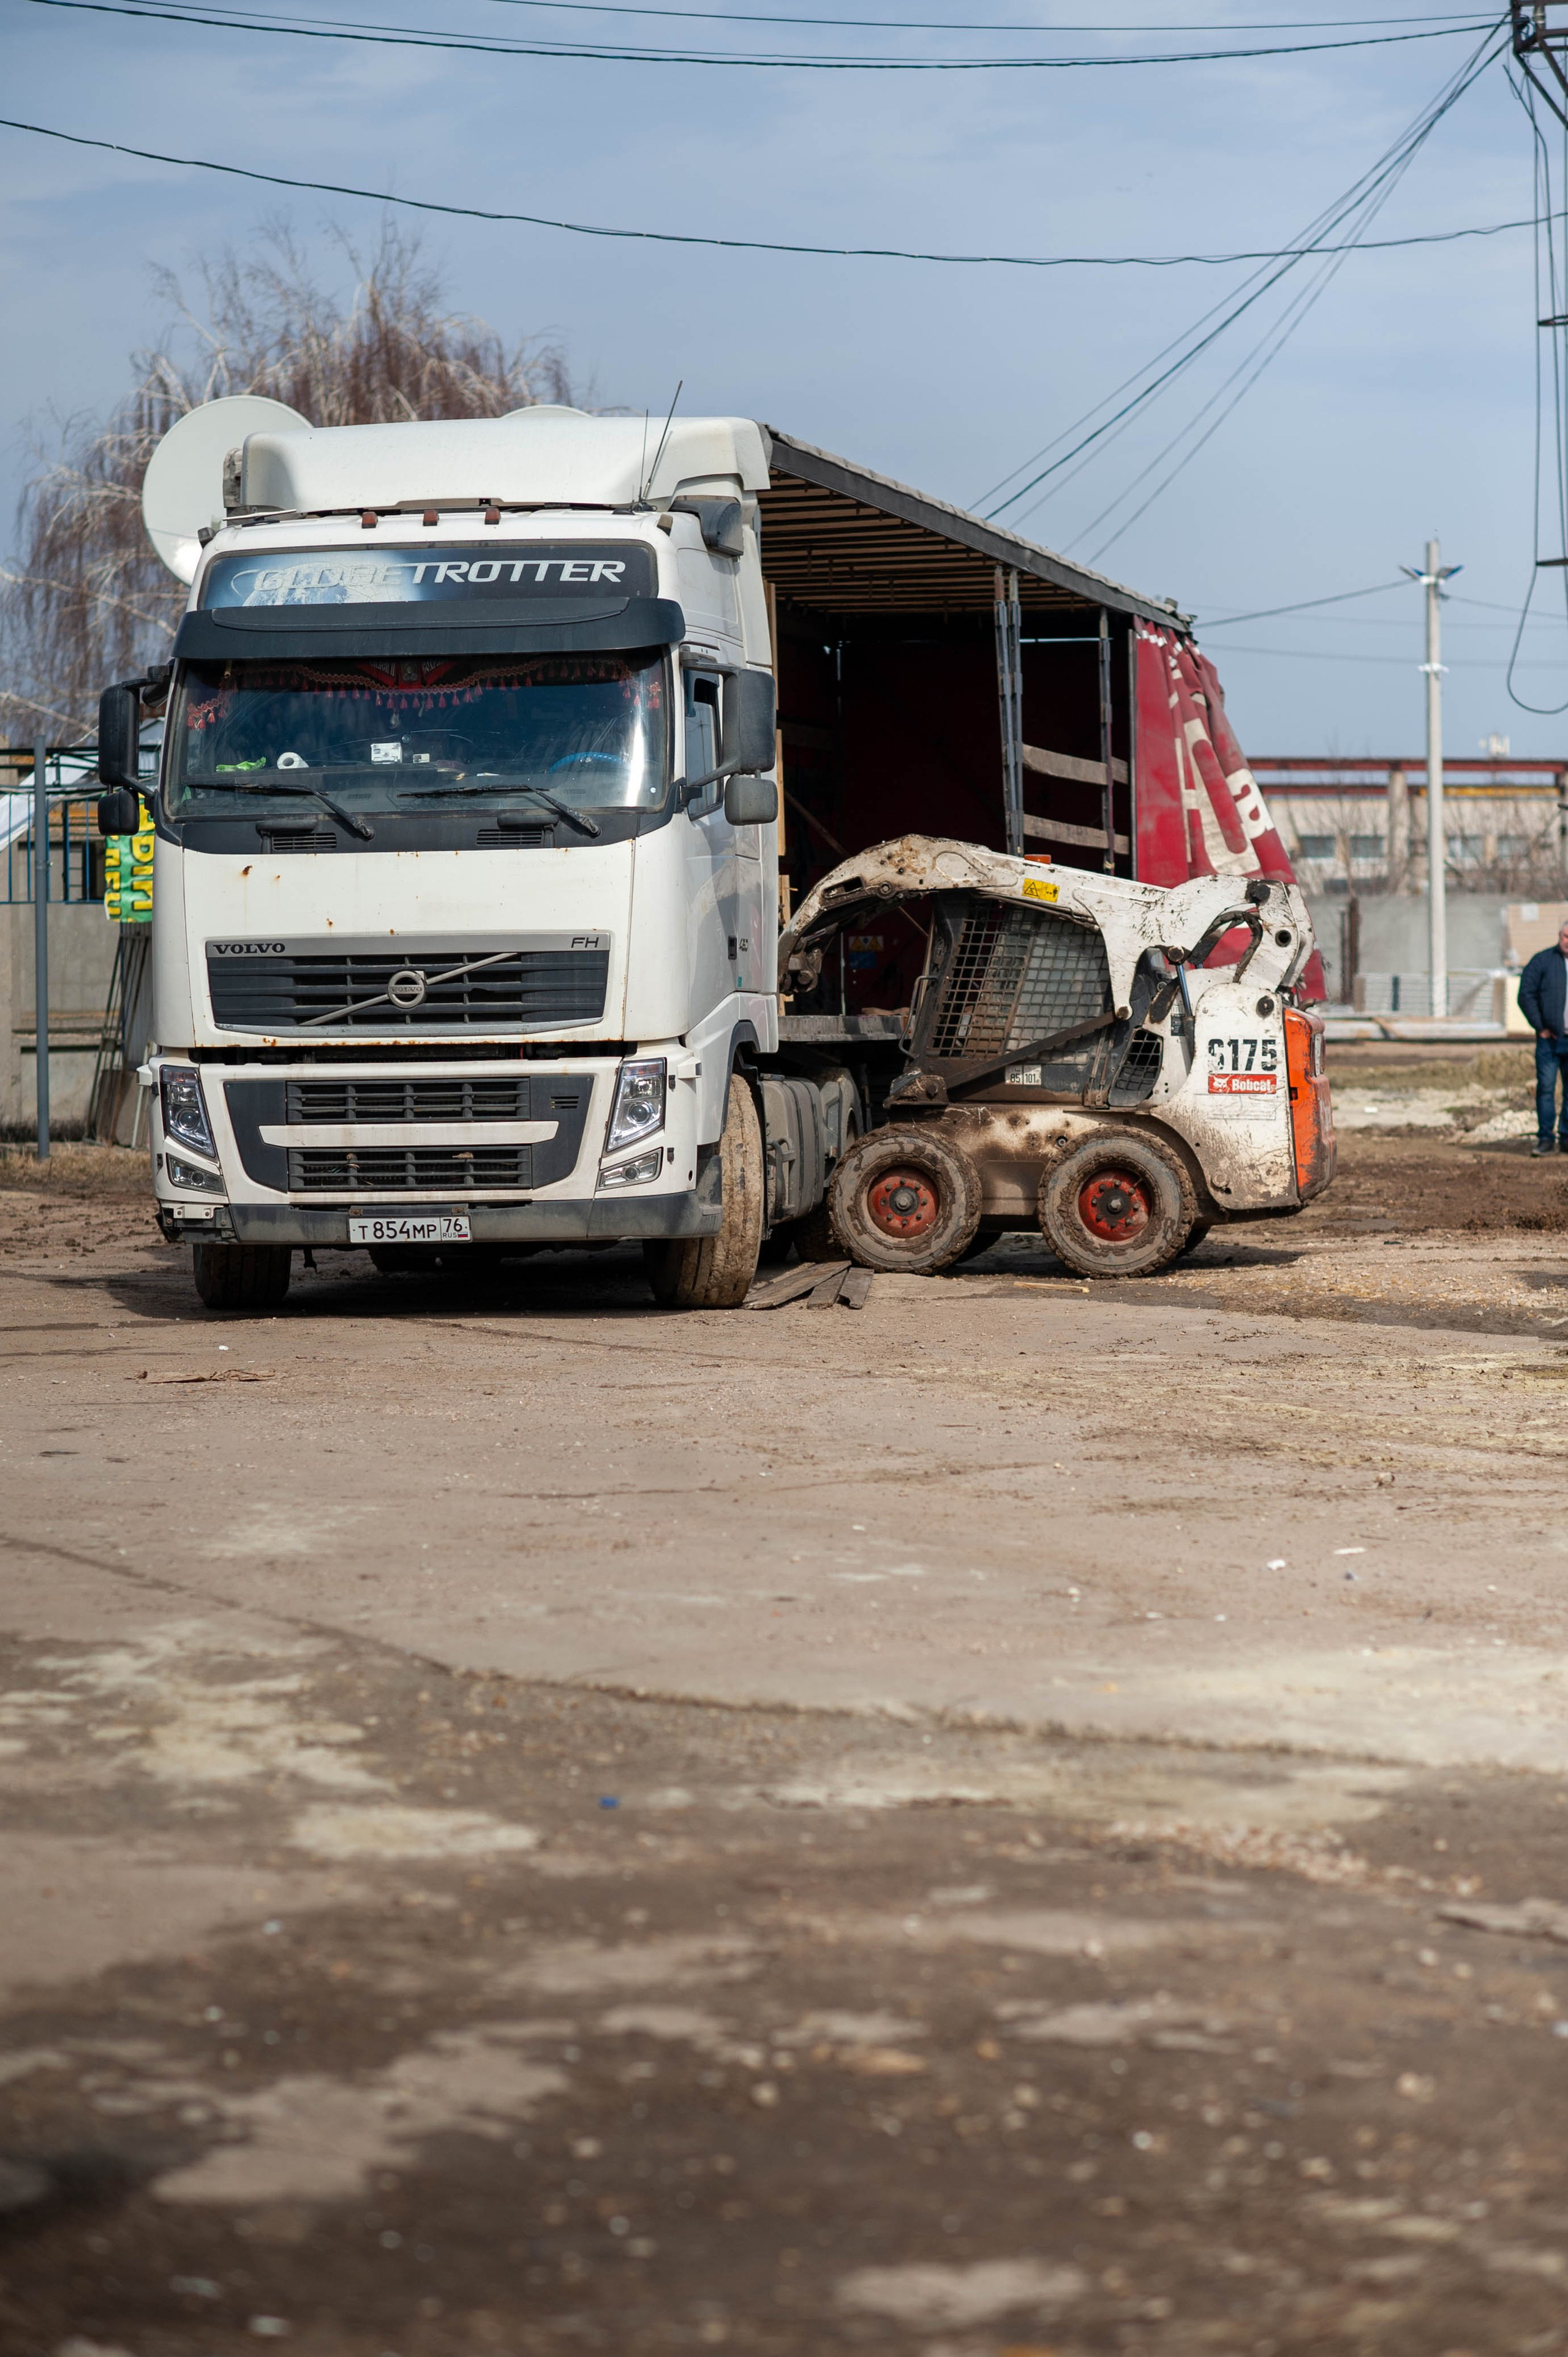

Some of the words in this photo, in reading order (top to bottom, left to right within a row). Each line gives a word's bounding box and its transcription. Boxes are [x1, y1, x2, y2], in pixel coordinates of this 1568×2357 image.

[253, 559, 627, 591] GLOBETROTTER
[571, 937, 599, 948] FH
[213, 943, 285, 955] VOLVO
[1208, 1039, 1278, 1072] S175
[1010, 1073, 1020, 1083] 85
[1025, 1073, 1036, 1083] 101
[1232, 1078, 1272, 1091] Bobcat
[443, 1218, 463, 1233] 76
